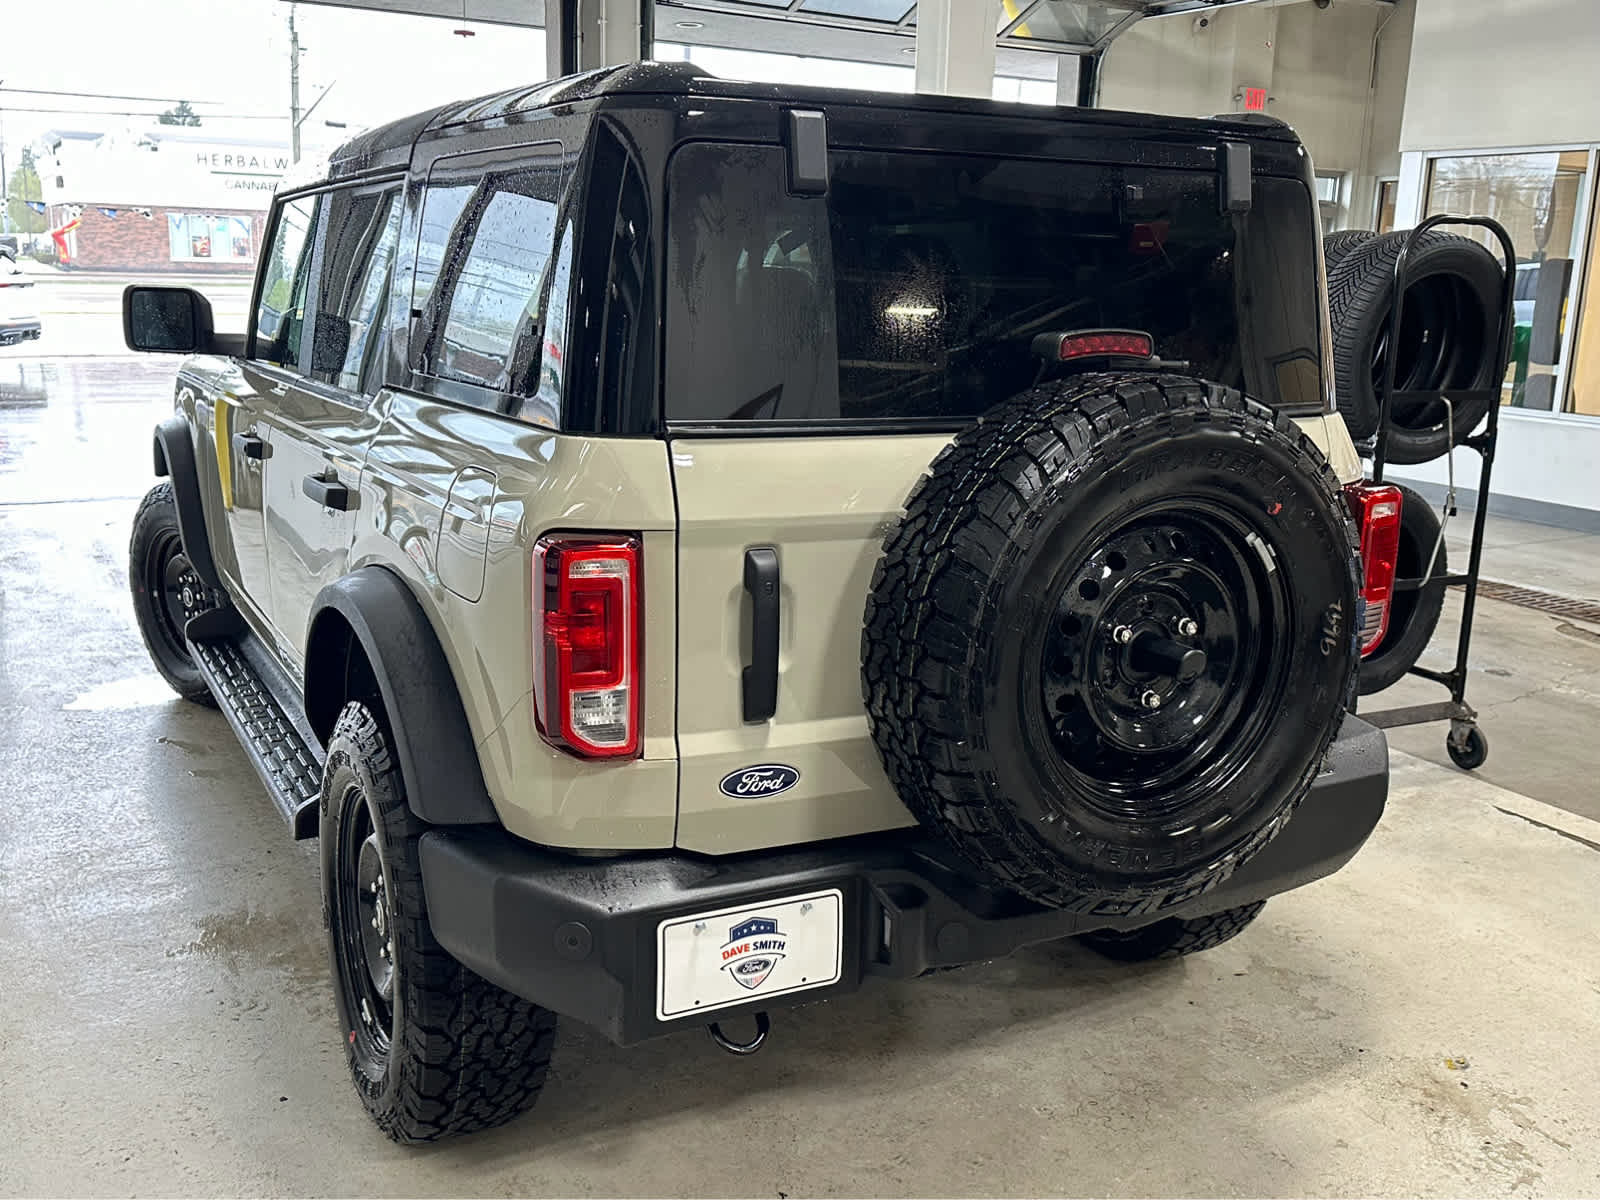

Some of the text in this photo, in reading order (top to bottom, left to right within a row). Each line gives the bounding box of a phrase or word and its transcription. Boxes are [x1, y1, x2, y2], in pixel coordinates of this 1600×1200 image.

[1245, 87, 1266, 111] EXIT
[736, 770, 786, 794] Ford
[721, 939, 787, 961] DAVE SMITH
